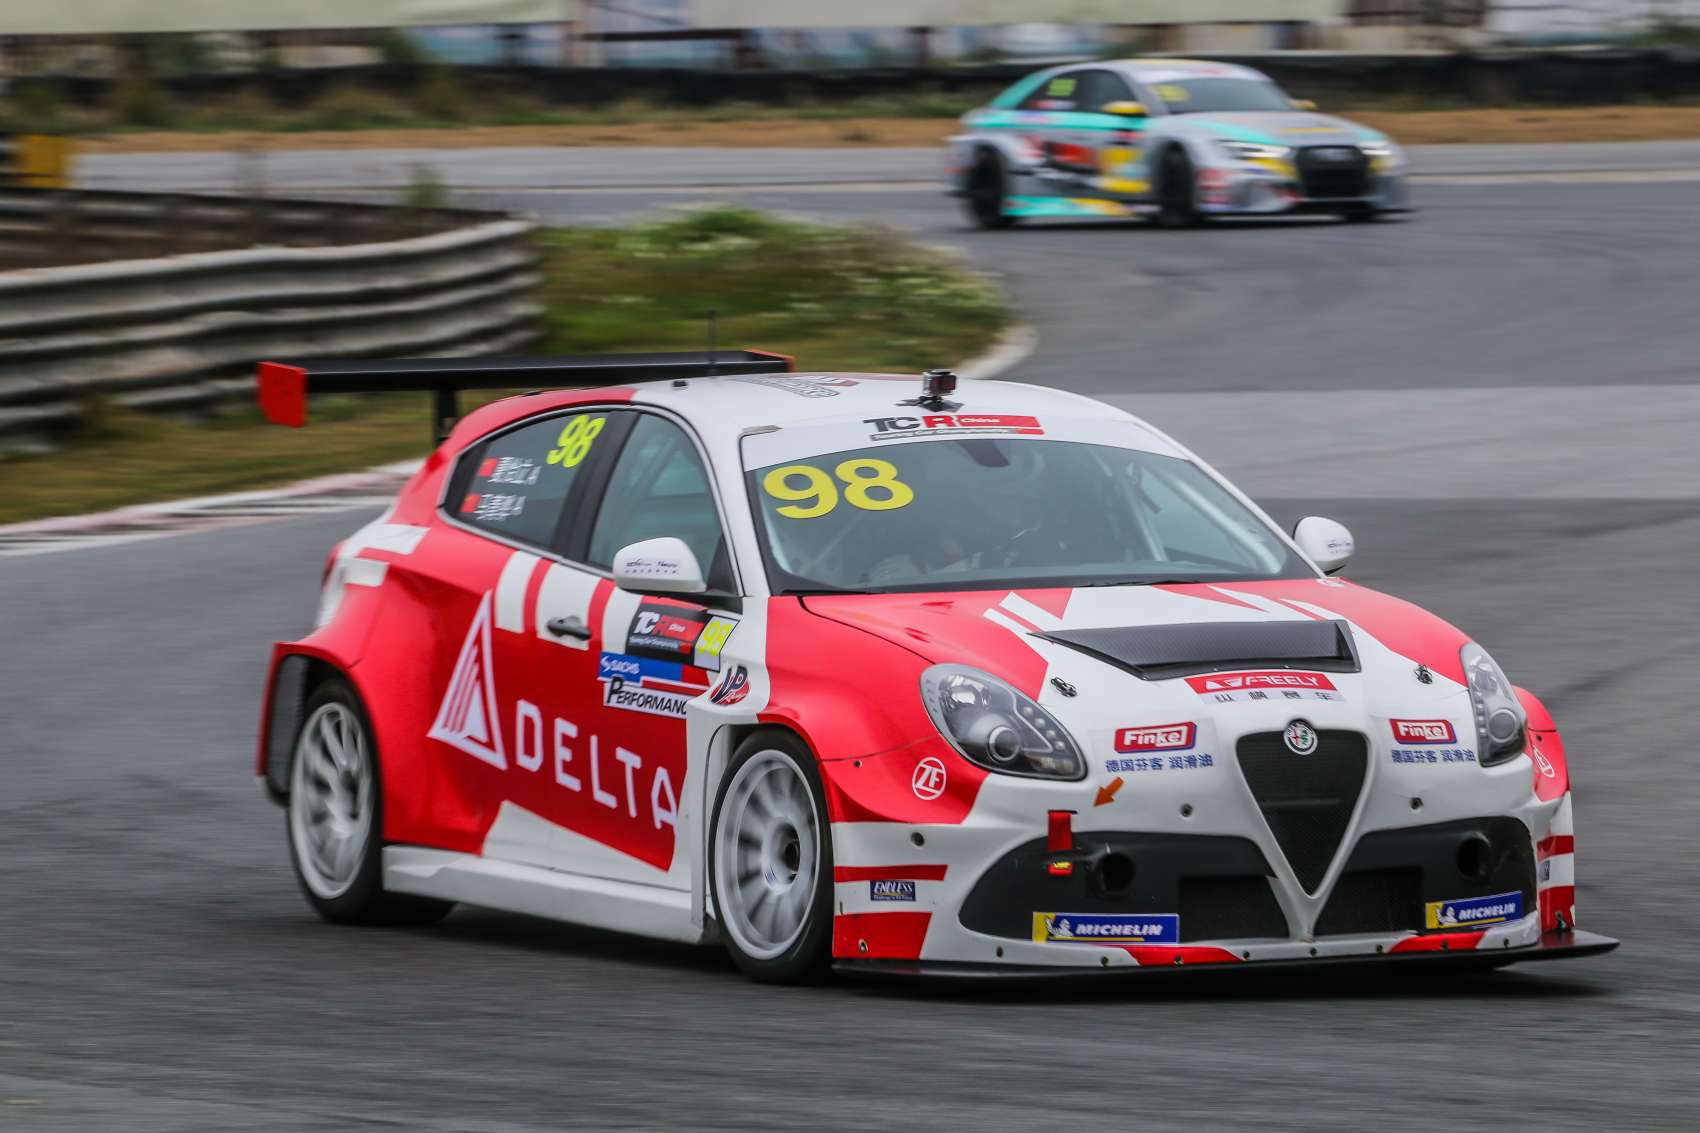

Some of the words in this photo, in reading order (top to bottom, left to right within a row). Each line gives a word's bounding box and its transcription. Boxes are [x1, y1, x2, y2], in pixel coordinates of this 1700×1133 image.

[863, 415, 957, 433] TCR
[546, 414, 606, 468] 98
[763, 458, 914, 519] 98
[695, 620, 733, 657] 98
[610, 659, 641, 675] SACHS
[1246, 675, 1320, 686] FREELY
[516, 699, 679, 830] DELTA
[915, 763, 945, 794] ZF
[1459, 902, 1516, 921] MICHELIN
[1076, 922, 1164, 937] MICHELIN
